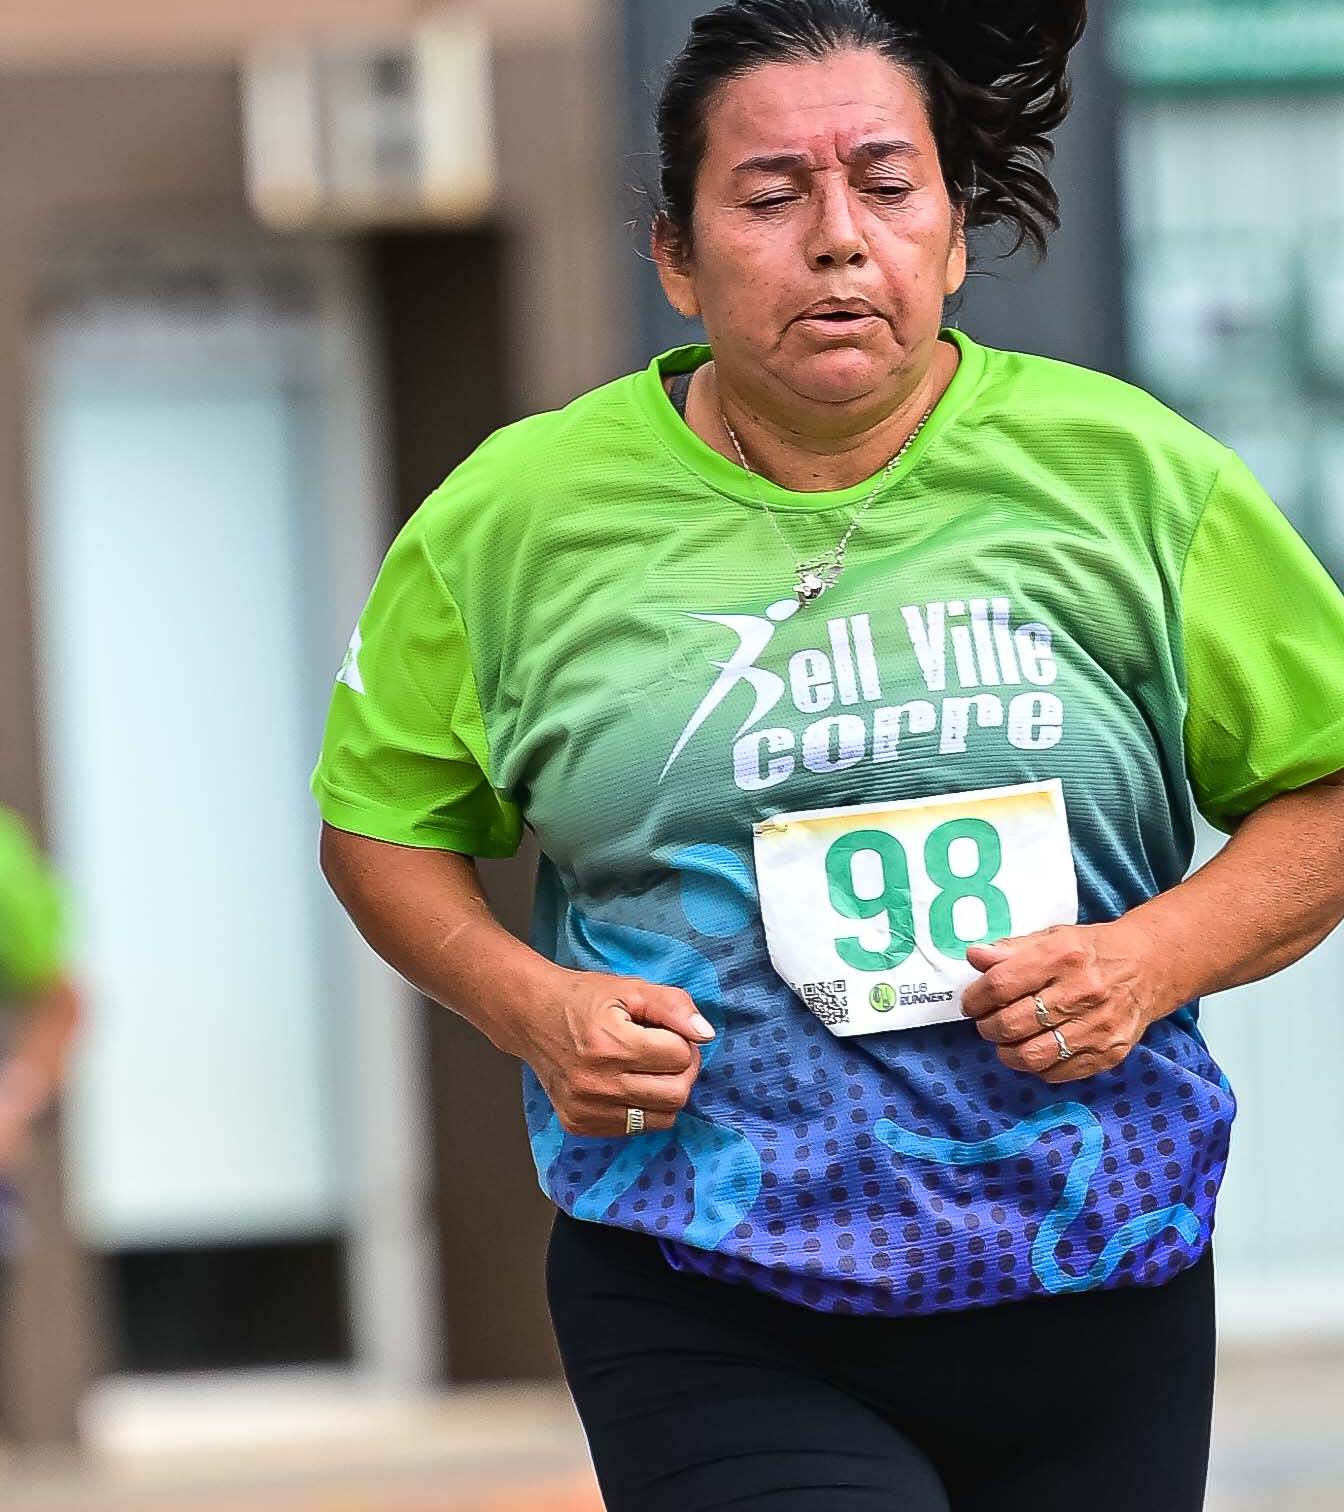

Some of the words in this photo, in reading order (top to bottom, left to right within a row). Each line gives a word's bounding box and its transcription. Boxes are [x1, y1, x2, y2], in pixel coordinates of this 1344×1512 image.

[901, 596, 1058, 690] Ville
[732, 692, 1065, 791] corre
[824, 818, 1012, 973] 98
